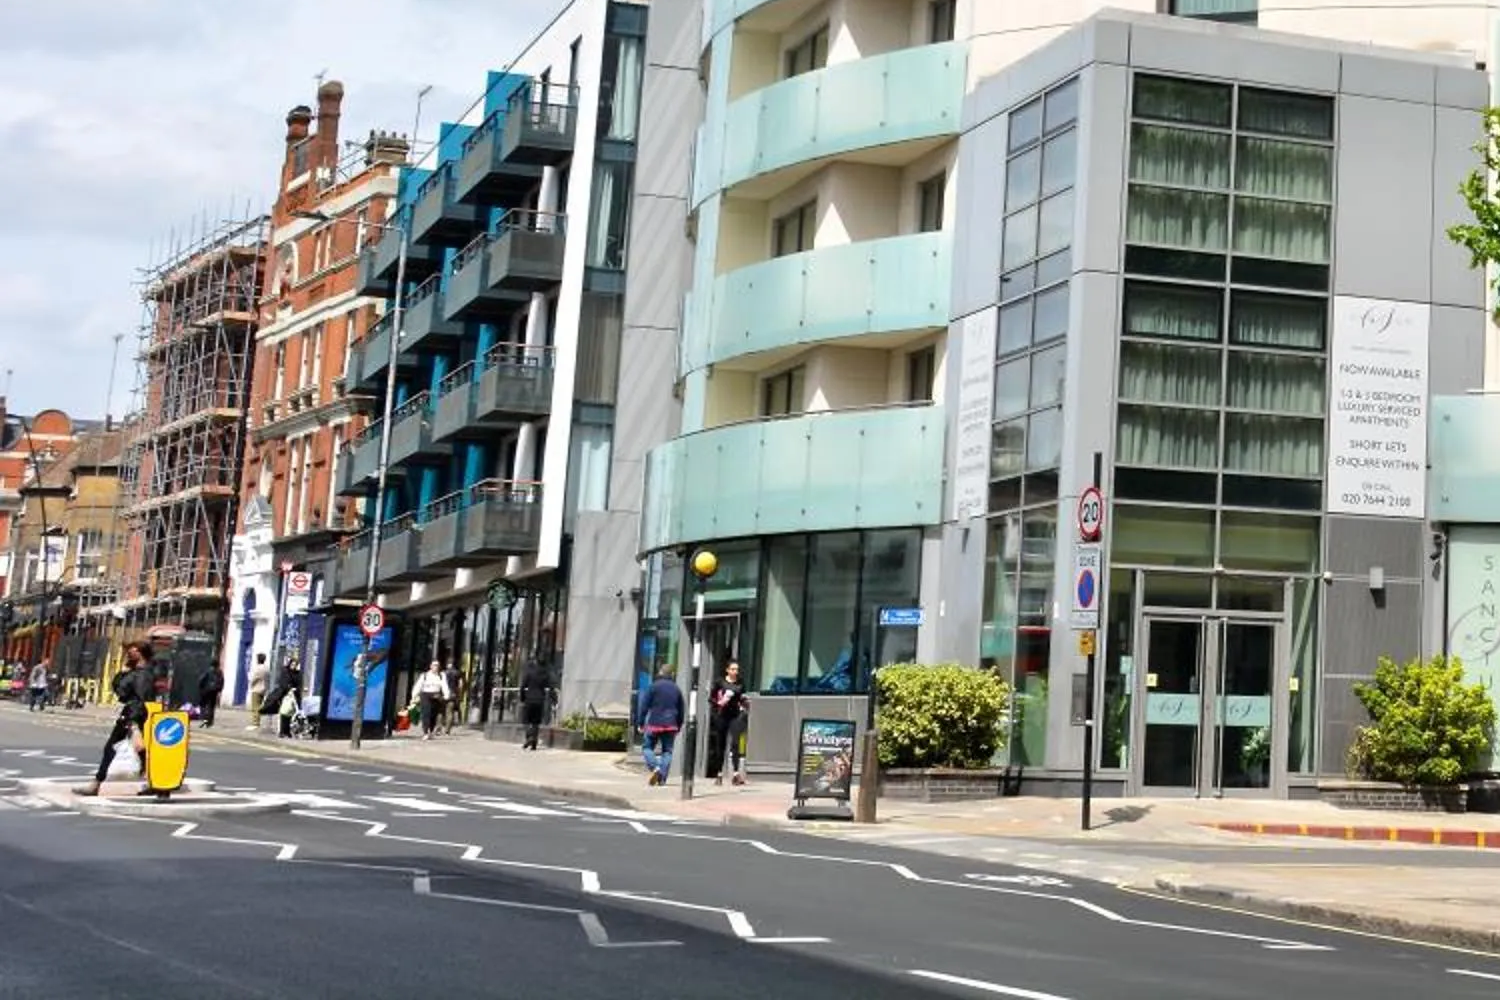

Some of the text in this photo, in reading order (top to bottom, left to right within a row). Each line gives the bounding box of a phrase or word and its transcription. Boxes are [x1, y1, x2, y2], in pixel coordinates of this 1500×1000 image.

[1339, 363, 1420, 378] NOW AVAILABLE
[1371, 391, 1421, 403] BEDROOM
[1338, 402, 1421, 417] LUXURY SERVICED
[1349, 415, 1409, 429] APARTMENTS
[1349, 440, 1407, 453] SHORT LETS
[1335, 456, 1419, 471] ENQUIRE WITHIN
[1341, 493, 1361, 504] 020
[1083, 502, 1099, 523] 20
[363, 612, 380, 627] 30
[1480, 555, 1496, 691] SANCTU
